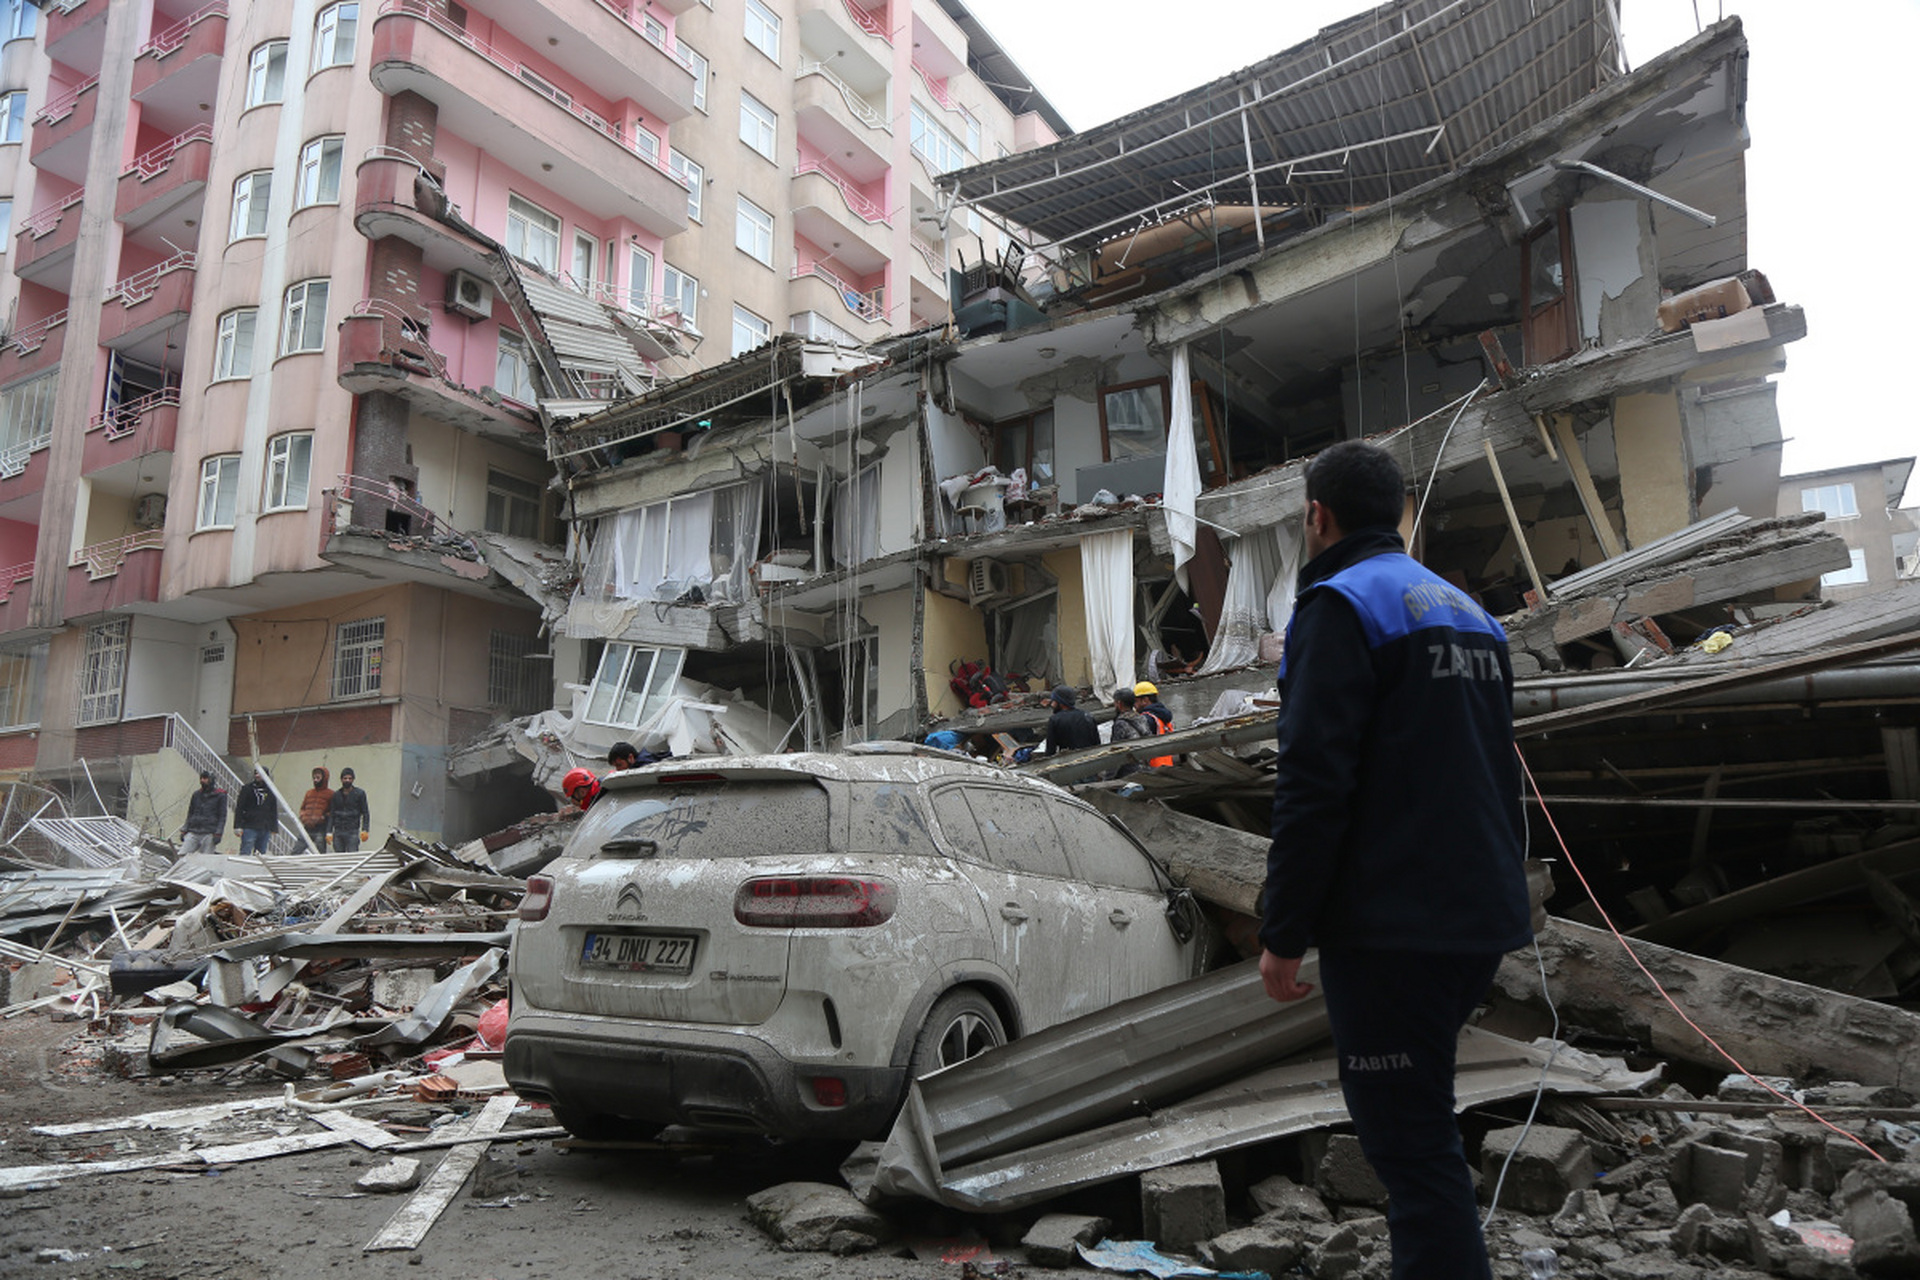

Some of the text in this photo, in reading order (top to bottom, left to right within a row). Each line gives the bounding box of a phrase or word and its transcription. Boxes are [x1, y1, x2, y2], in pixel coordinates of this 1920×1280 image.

[591, 937, 611, 960] 34
[617, 938, 652, 962] DNU
[655, 940, 690, 964] 227
[1347, 1052, 1413, 1071] ZABITA
